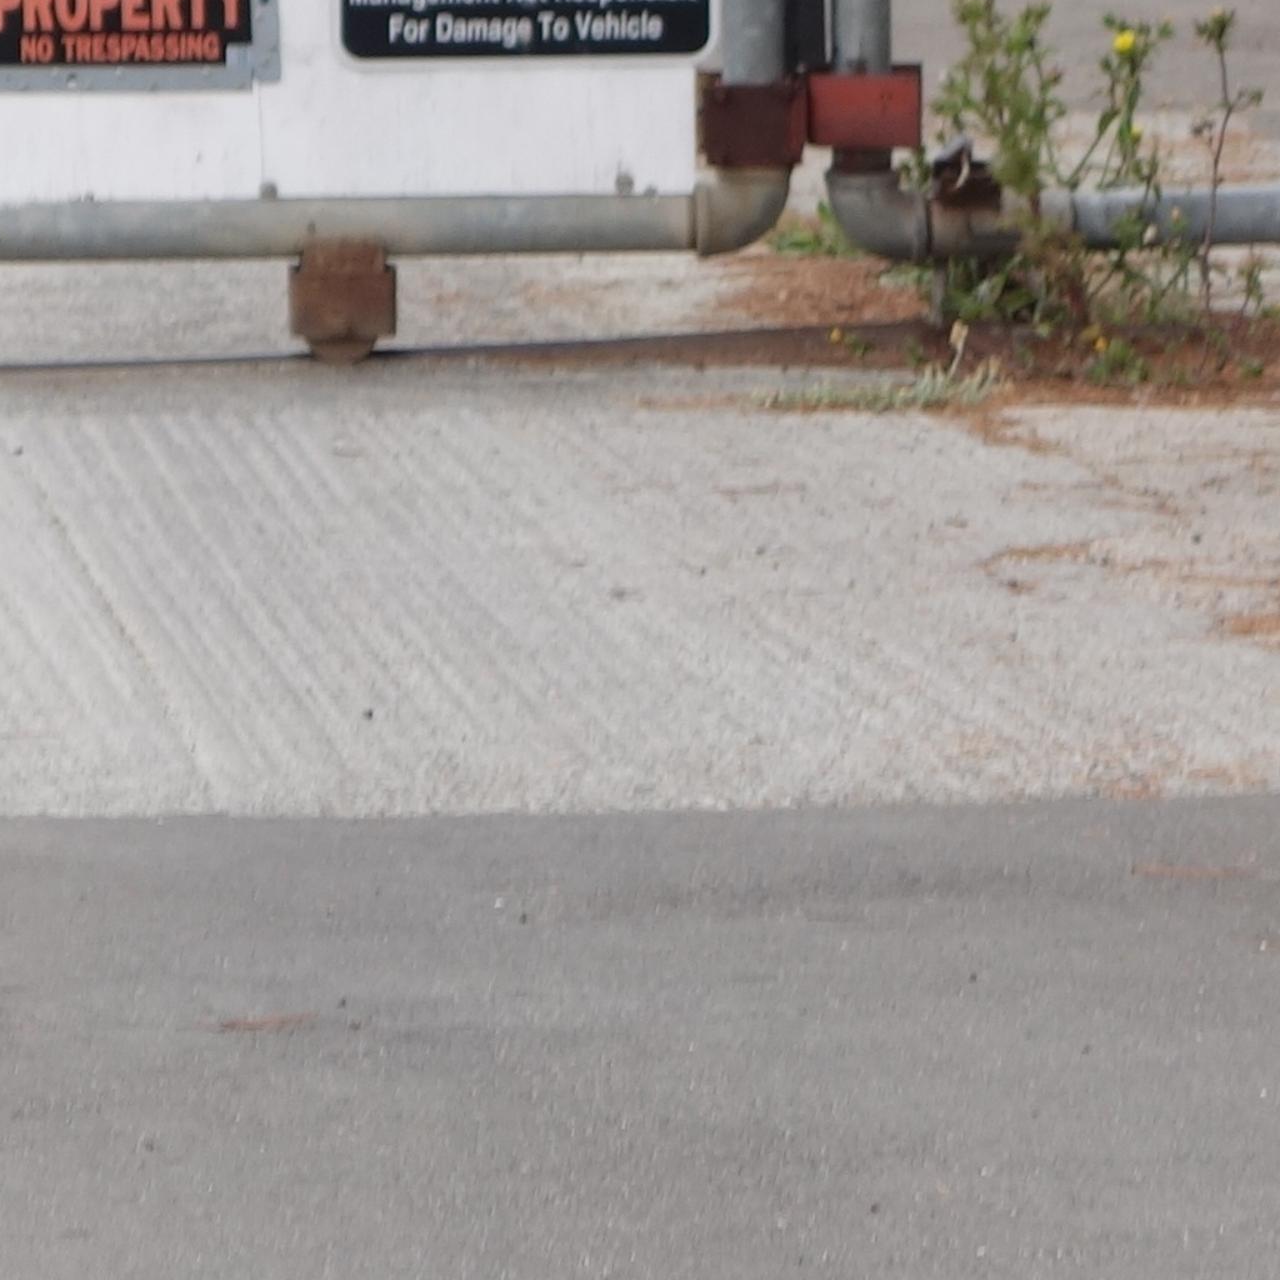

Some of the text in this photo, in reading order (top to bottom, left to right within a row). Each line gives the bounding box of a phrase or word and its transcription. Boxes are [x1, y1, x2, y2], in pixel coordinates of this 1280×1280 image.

[388, 8, 663, 49] For Damage To Vehicle
[20, 31, 220, 64] NO TRESPASSING
